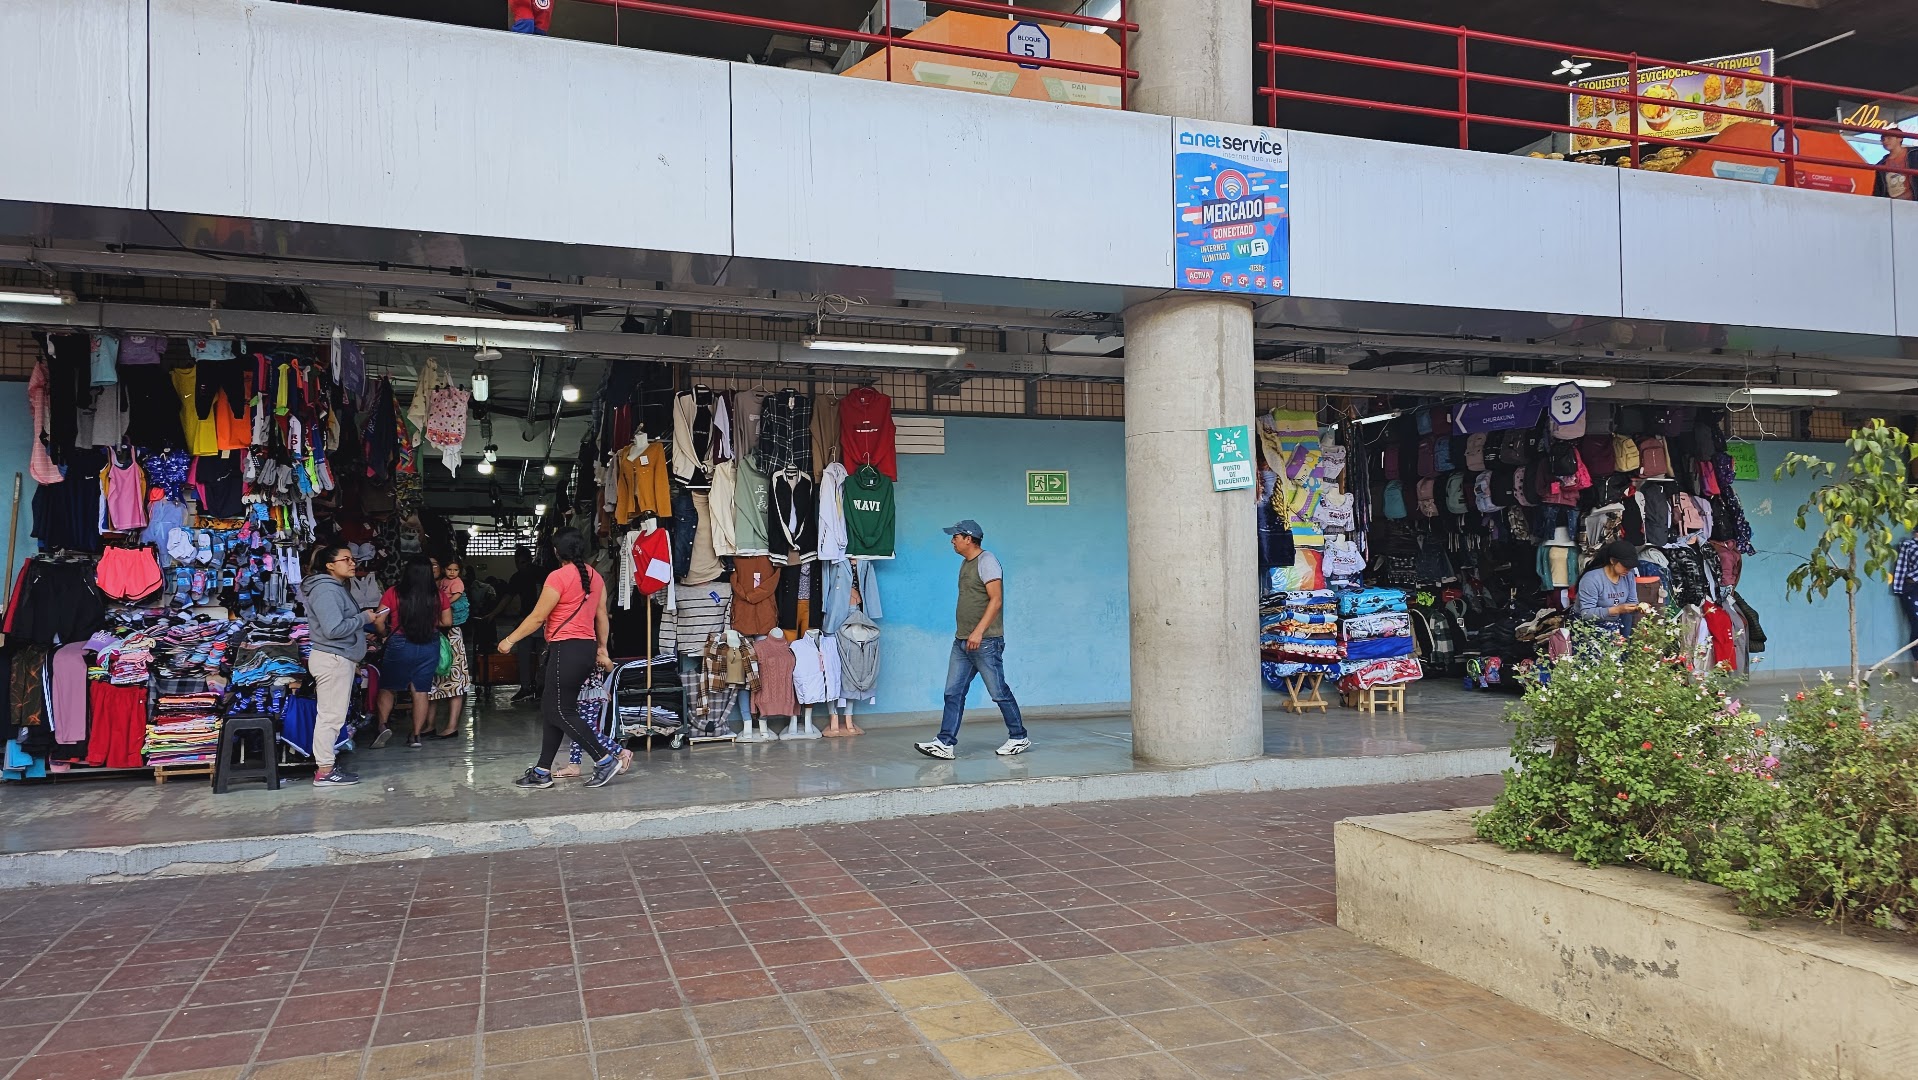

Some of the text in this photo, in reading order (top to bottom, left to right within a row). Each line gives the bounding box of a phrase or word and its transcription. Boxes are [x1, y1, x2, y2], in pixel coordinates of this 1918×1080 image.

[1017, 35, 1041, 43] BLOQUE
[1024, 43, 1035, 57] 5
[1716, 55, 1762, 70] OTAVALO
[971, 70, 988, 78] PAN
[1071, 83, 1087, 91] PAN
[1222, 151, 1250, 161] internet
[1203, 199, 1263, 225] MERCADO
[1213, 224, 1254, 240] CONECTADO
[1200, 242, 1227, 253] INTERNET
[1189, 270, 1211, 280] ACTIVA
[1554, 392, 1580, 401] CORREDOR
[1492, 401, 1515, 411] ROPA
[1562, 401, 1572, 415] 3
[1482, 414, 1515, 424] CHURAKUNA
[1222, 464, 1241, 472] PUNTO
[1217, 476, 1250, 486] ENCUENTRO
